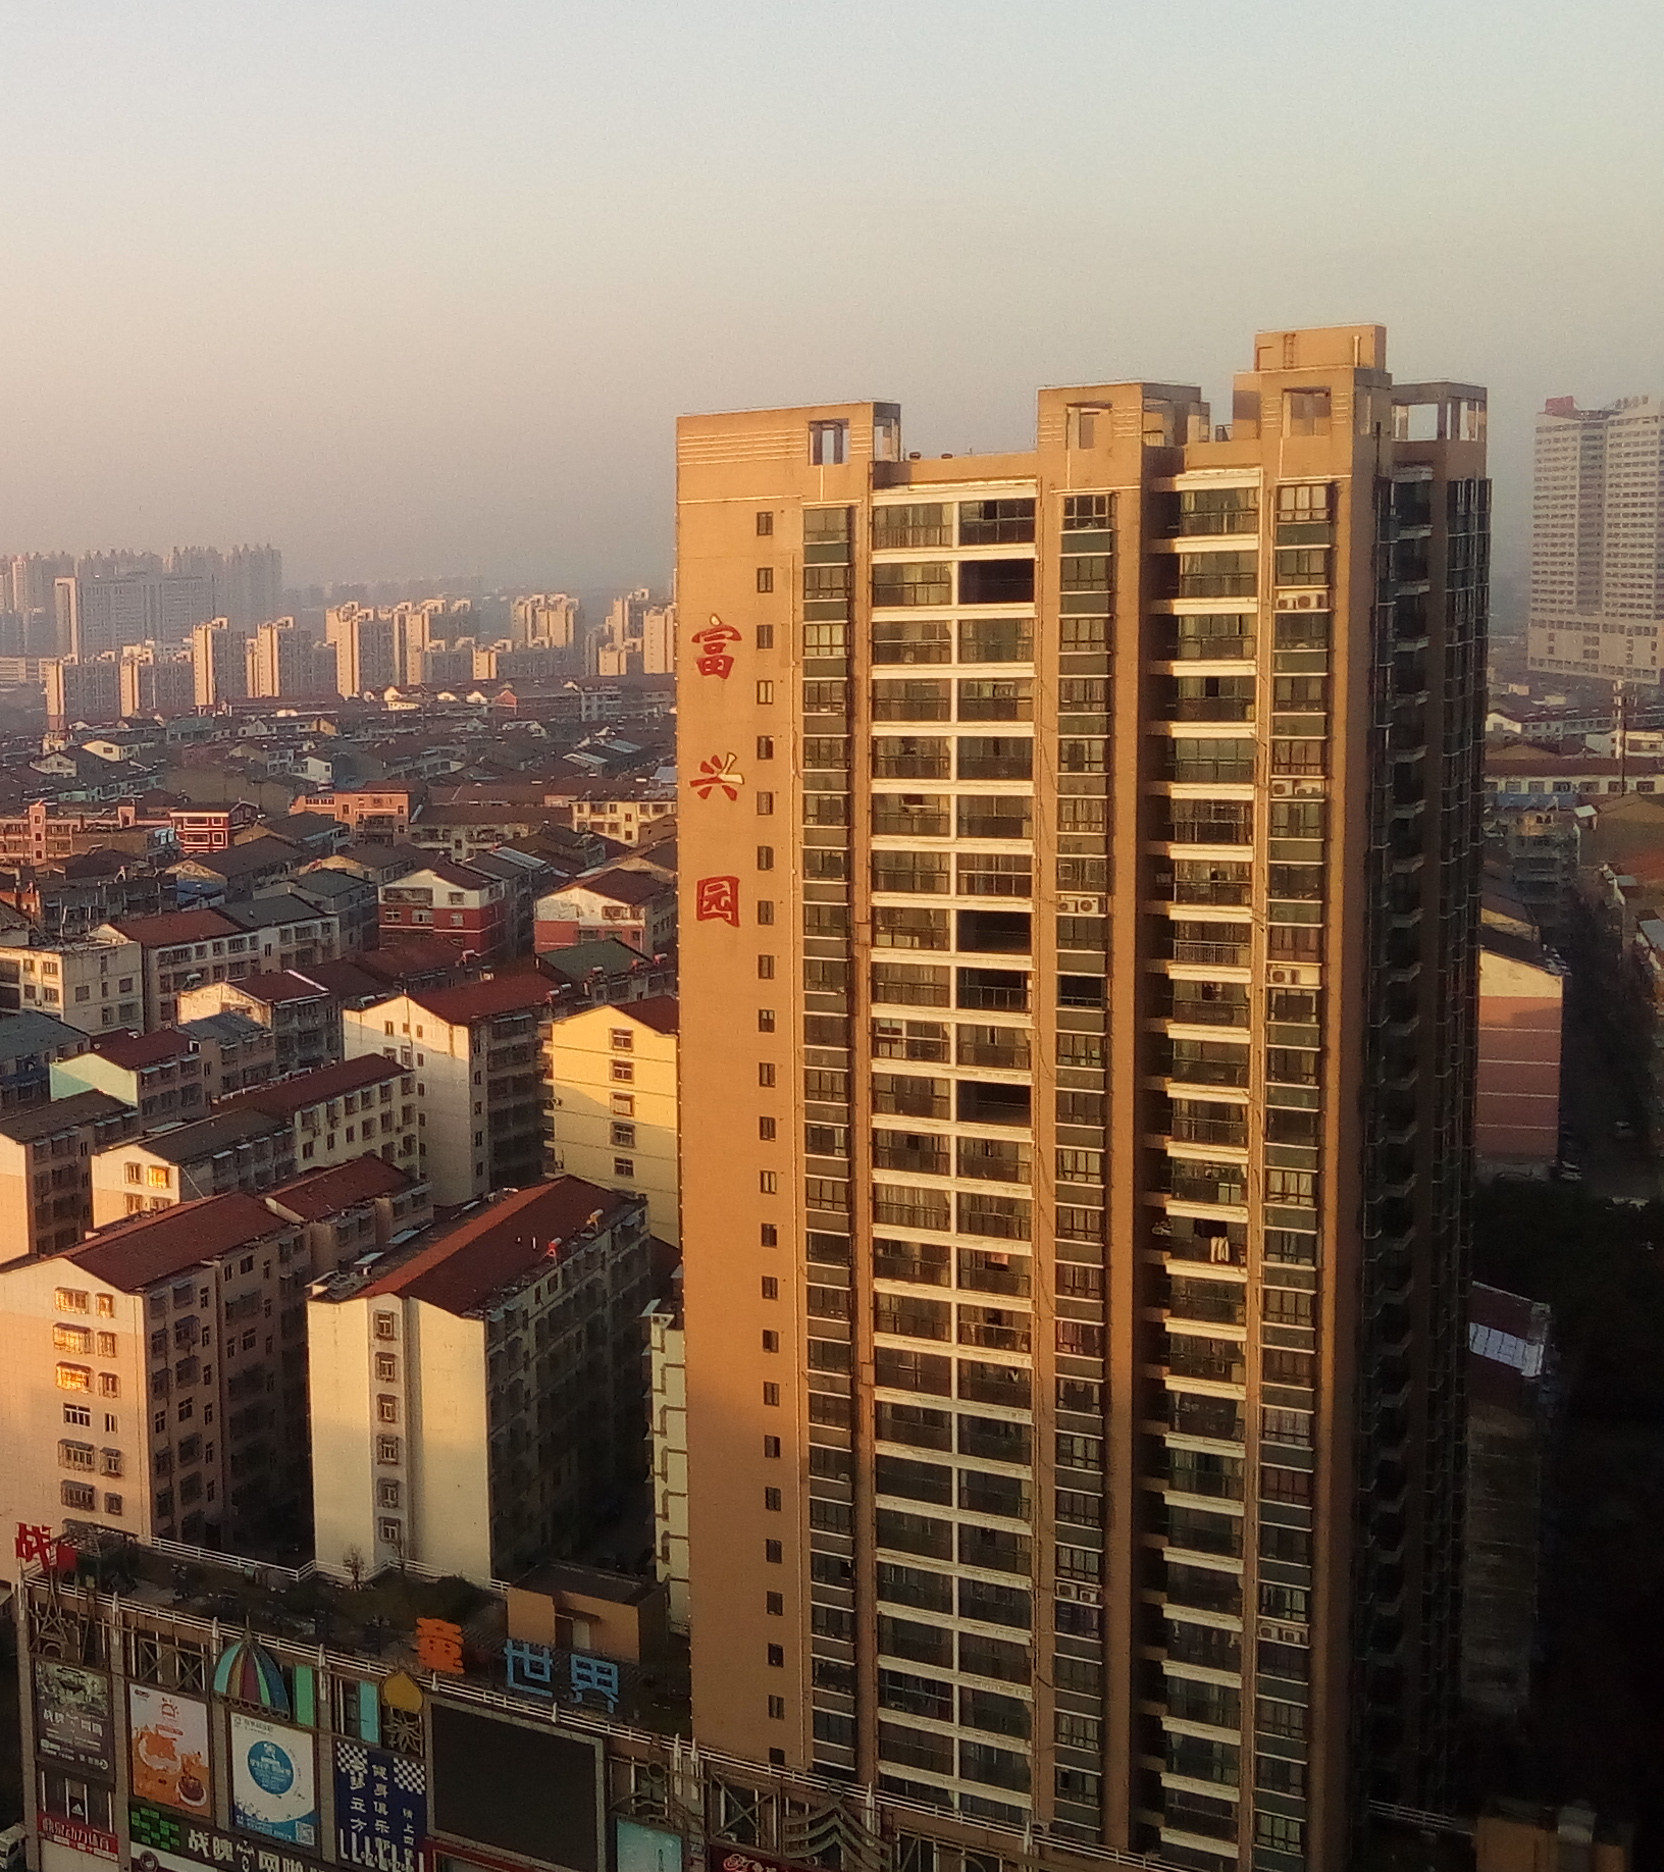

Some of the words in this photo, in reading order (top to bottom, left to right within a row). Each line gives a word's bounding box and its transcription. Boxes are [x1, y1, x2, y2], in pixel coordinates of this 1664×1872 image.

[690, 614, 744, 927] 富兴园
[15, 1521, 54, 1572] 战
[502, 1638, 620, 1714] 世界
